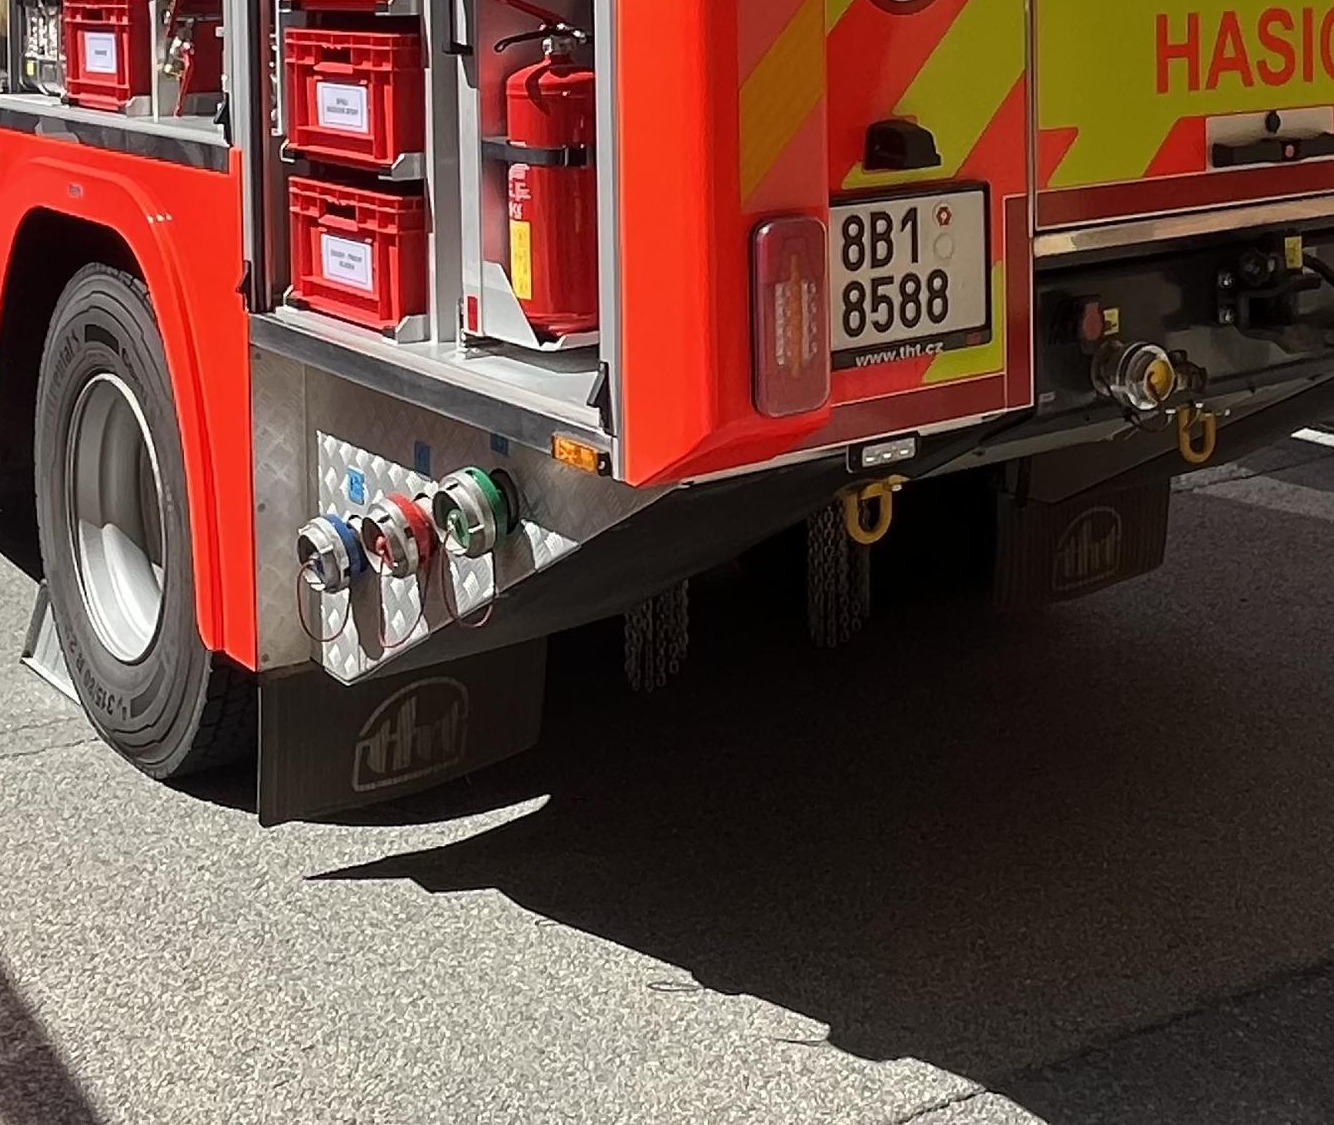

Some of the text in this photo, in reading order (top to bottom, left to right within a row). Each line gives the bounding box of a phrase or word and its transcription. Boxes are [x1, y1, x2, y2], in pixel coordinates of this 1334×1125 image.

[842, 206, 919, 272] 8B1
[842, 268, 949, 338] 8588
[855, 340, 945, 367] www.tht.cz
